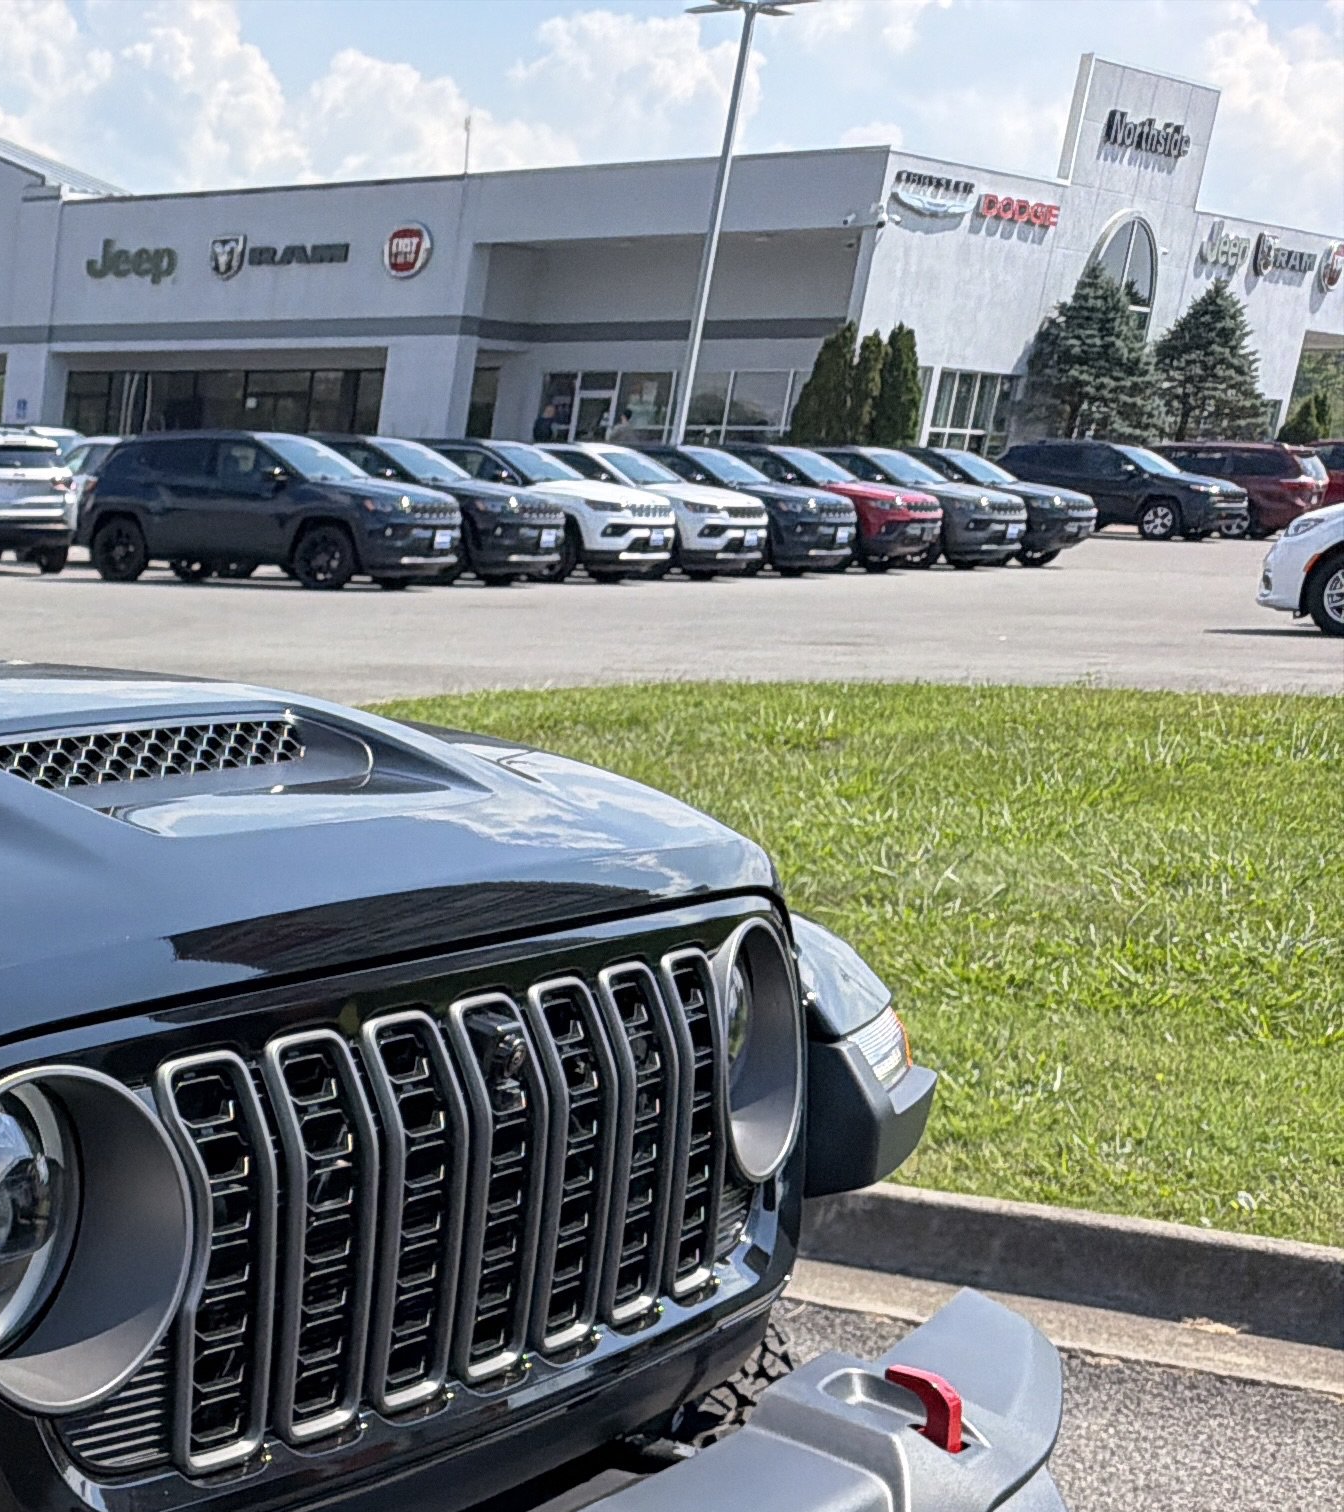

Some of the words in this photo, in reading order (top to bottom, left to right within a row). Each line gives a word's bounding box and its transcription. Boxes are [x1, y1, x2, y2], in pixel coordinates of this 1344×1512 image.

[1107, 109, 1191, 158] Northside
[981, 193, 1060, 227] DODGE
[86, 238, 177, 284] Jeep
[248, 243, 350, 266] RAM
[1275, 247, 1316, 272] RAM
